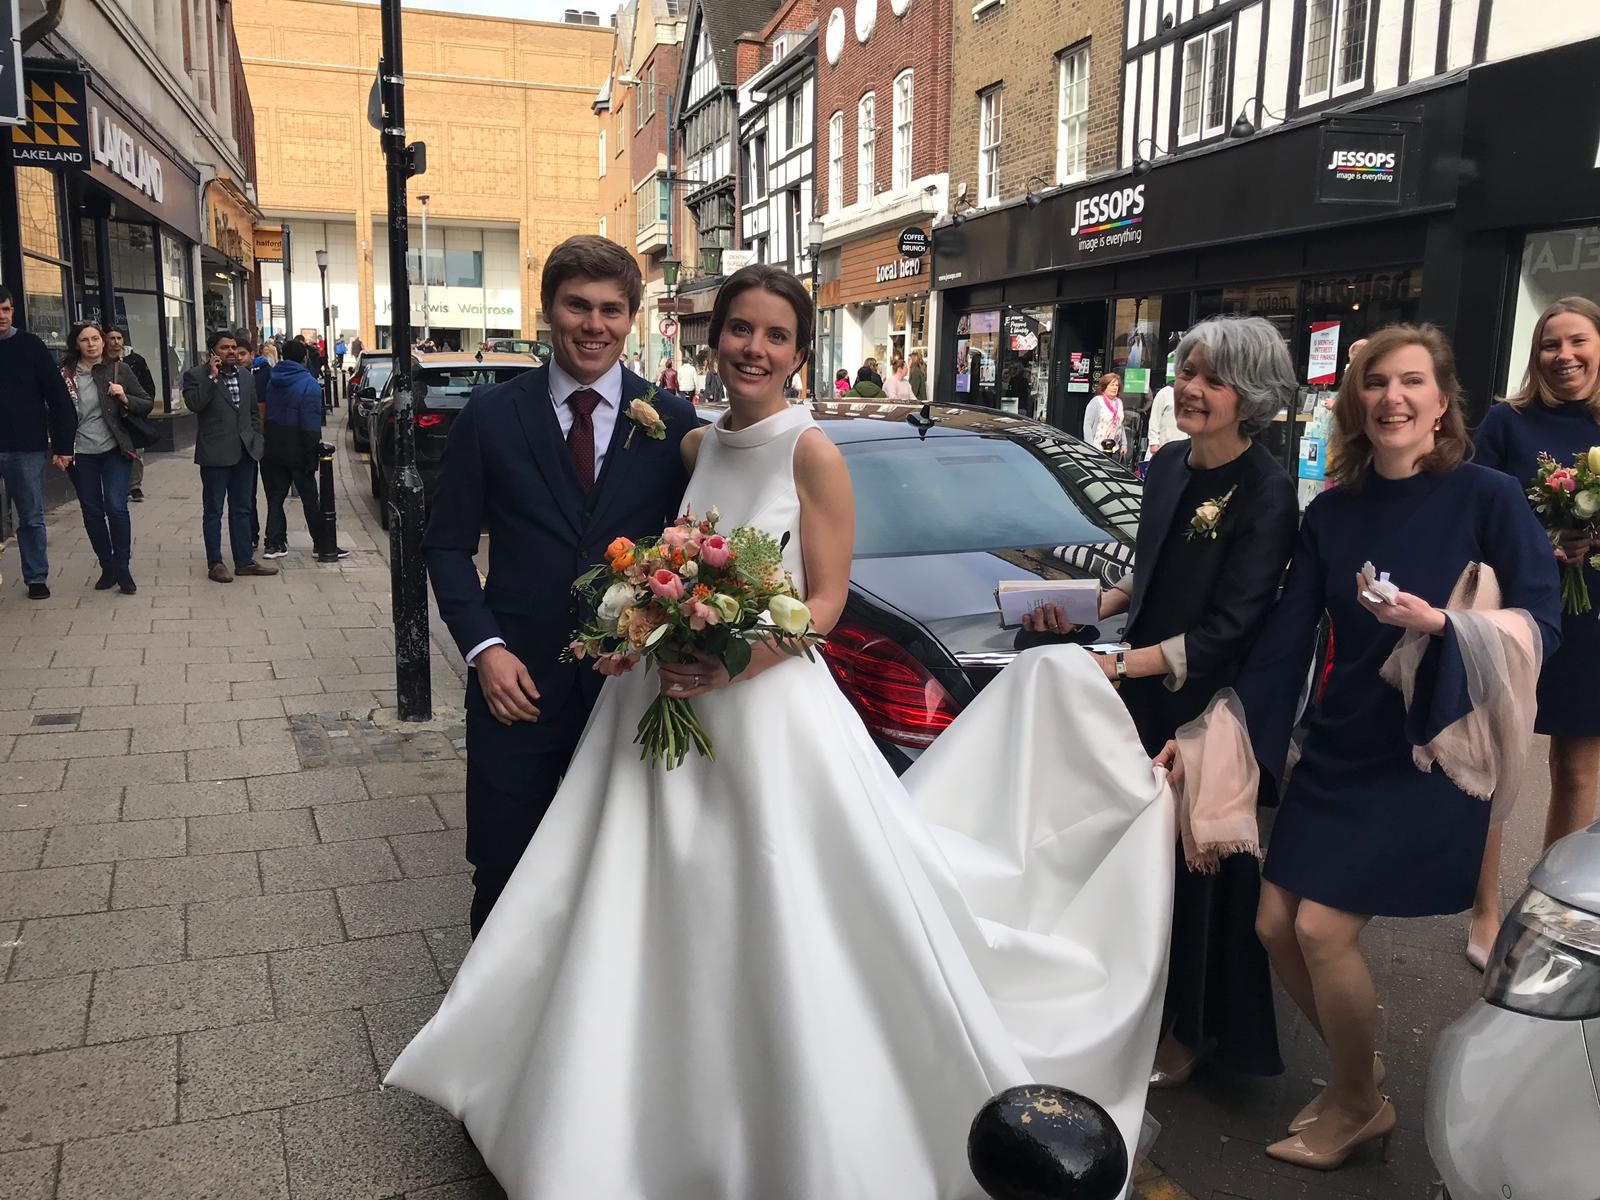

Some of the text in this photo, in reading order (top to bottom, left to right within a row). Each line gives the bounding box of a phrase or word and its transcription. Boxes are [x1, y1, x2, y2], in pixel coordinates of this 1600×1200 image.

[12, 148, 83, 163] LAKELAND
[92, 106, 163, 204] LAKELAND
[1328, 150, 1395, 170] JESSOPS
[1336, 171, 1393, 182] image is everything
[1070, 183, 1145, 236] JESSOPS
[903, 233, 925, 241] COFFEE
[1078, 228, 1142, 252] image is everything
[899, 258, 920, 278] hero
[415, 301, 449, 313] Lewis
[457, 303, 514, 315] Waitrose
